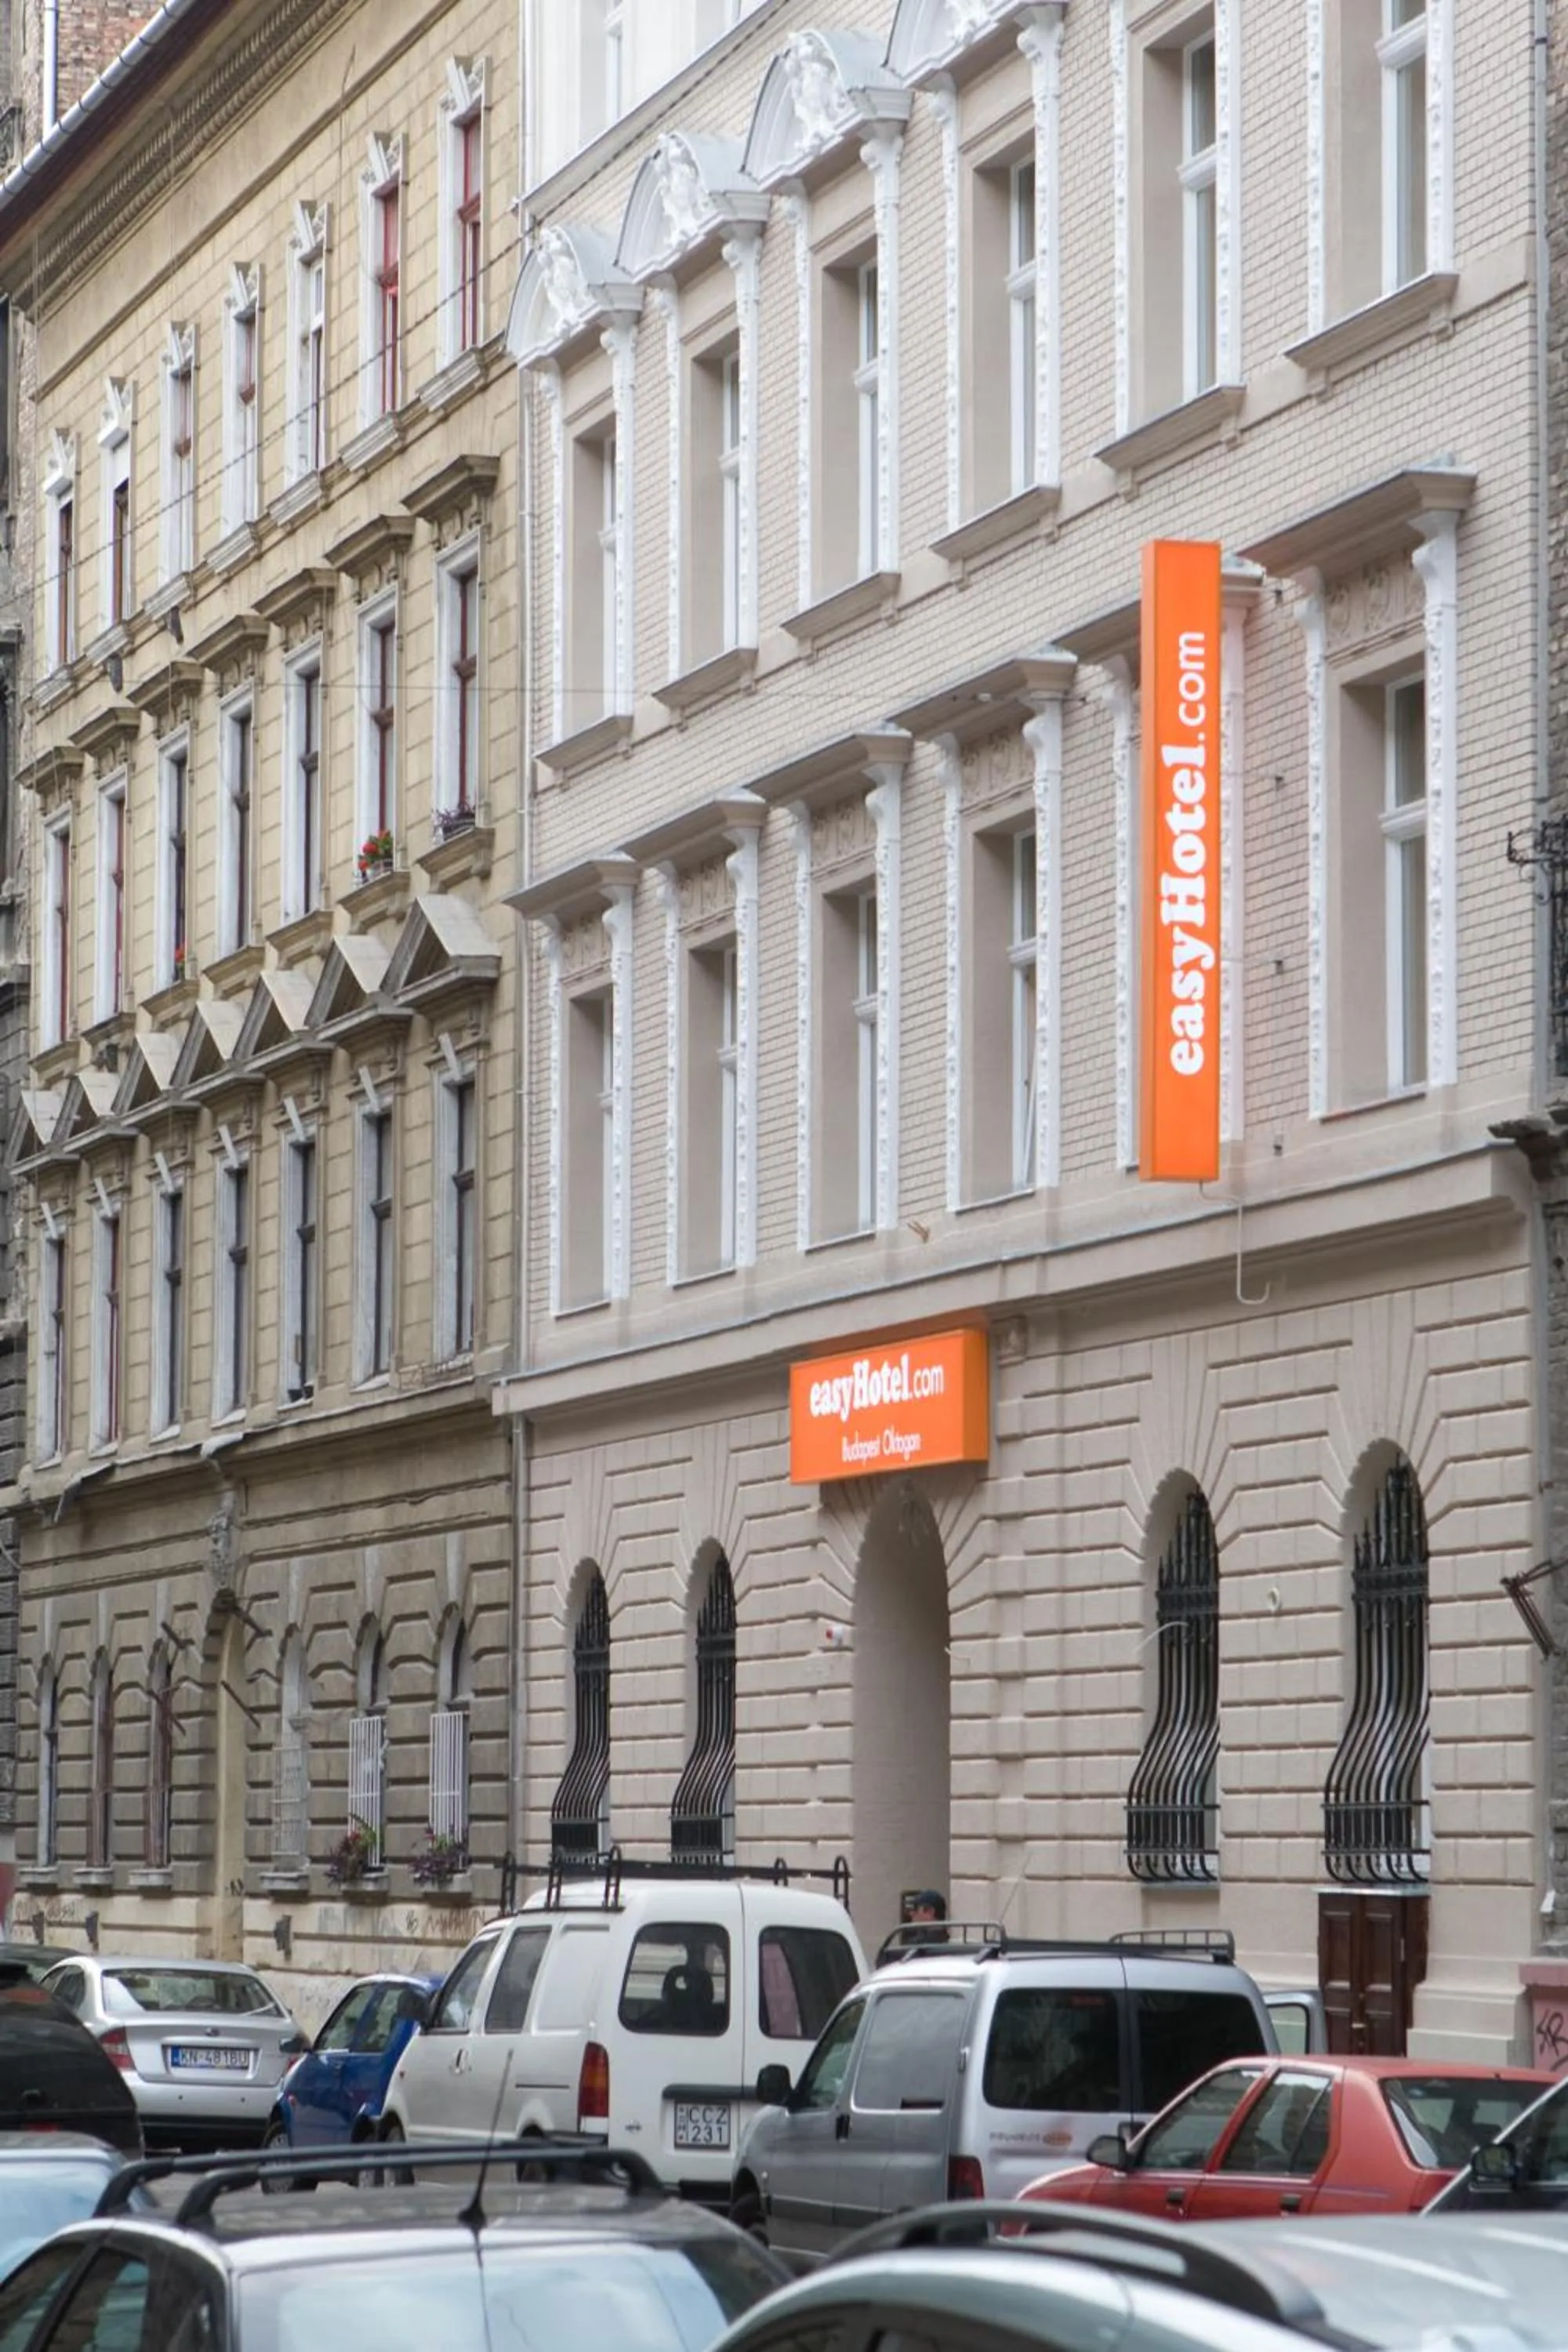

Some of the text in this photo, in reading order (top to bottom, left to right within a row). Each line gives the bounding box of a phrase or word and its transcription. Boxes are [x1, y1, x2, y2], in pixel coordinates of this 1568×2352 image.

[1160, 632, 1216, 1076] easyHotel.com
[809, 1352, 945, 1422] easyHotel.com
[842, 1431, 880, 1465] Budapest
[689, 2107, 727, 2125] CCZ
[691, 2125, 723, 2143] 231
